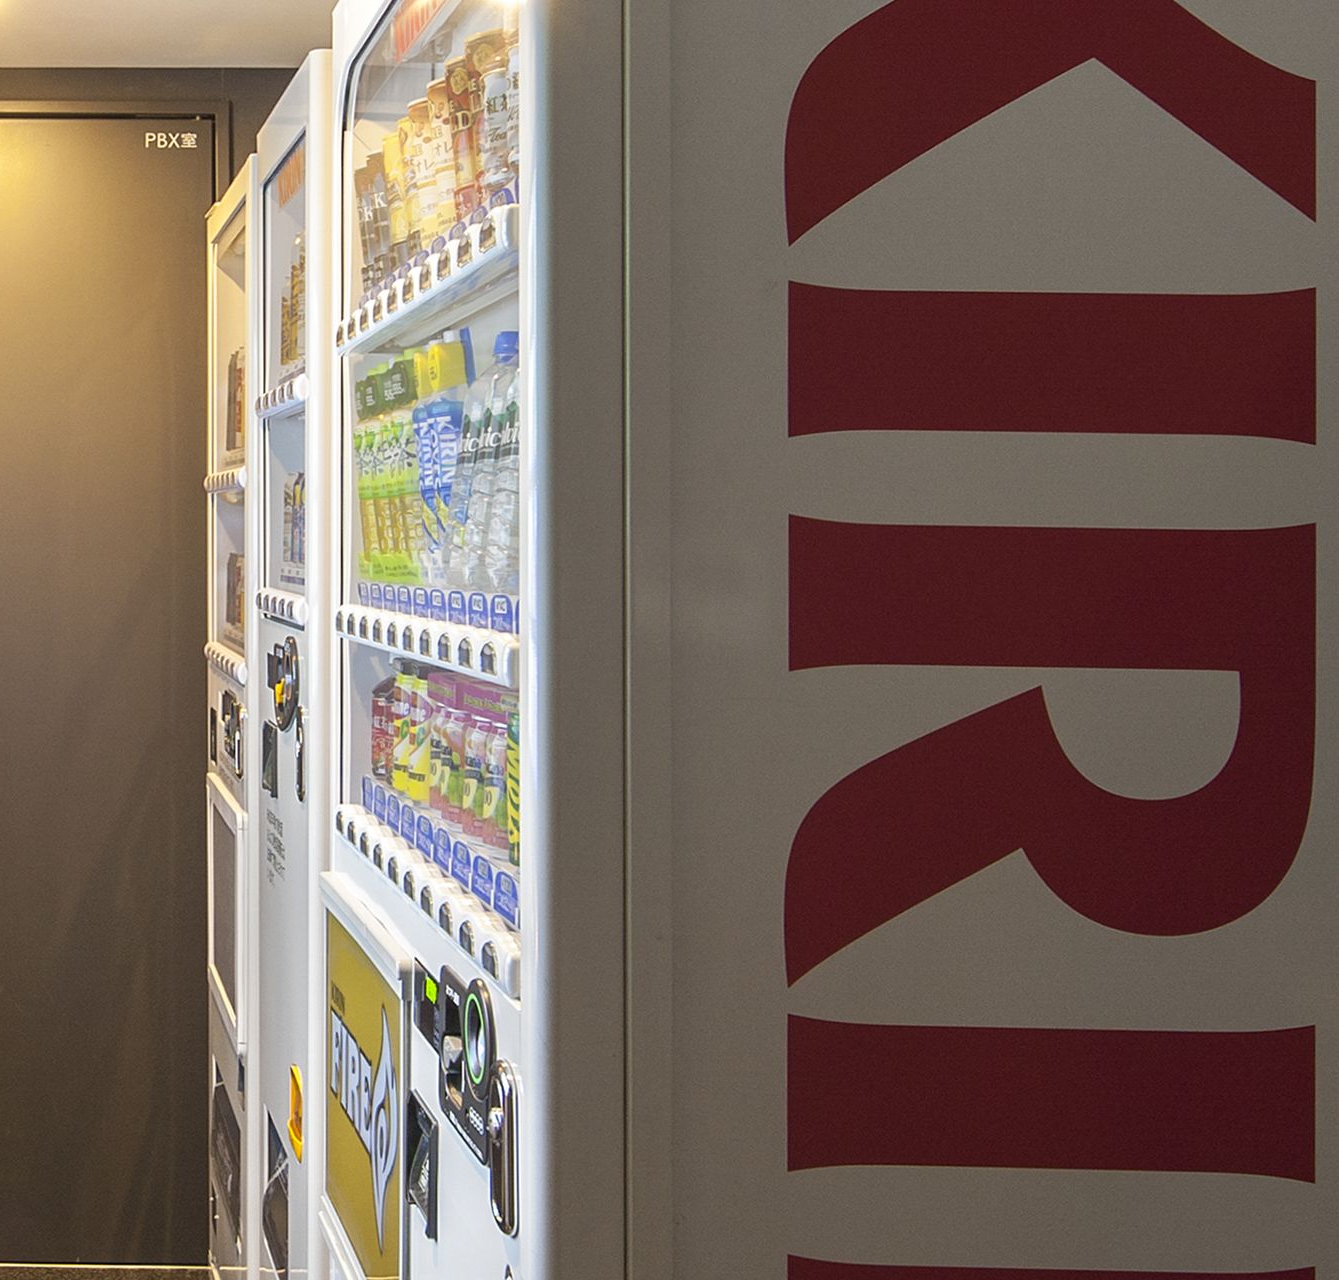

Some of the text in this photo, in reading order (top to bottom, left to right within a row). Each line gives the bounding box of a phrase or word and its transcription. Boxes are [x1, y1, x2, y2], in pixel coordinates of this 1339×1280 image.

[145, 132, 198, 149] PBX室
[437, 416, 460, 484] KIRIN
[330, 1006, 372, 1153] FIRE
